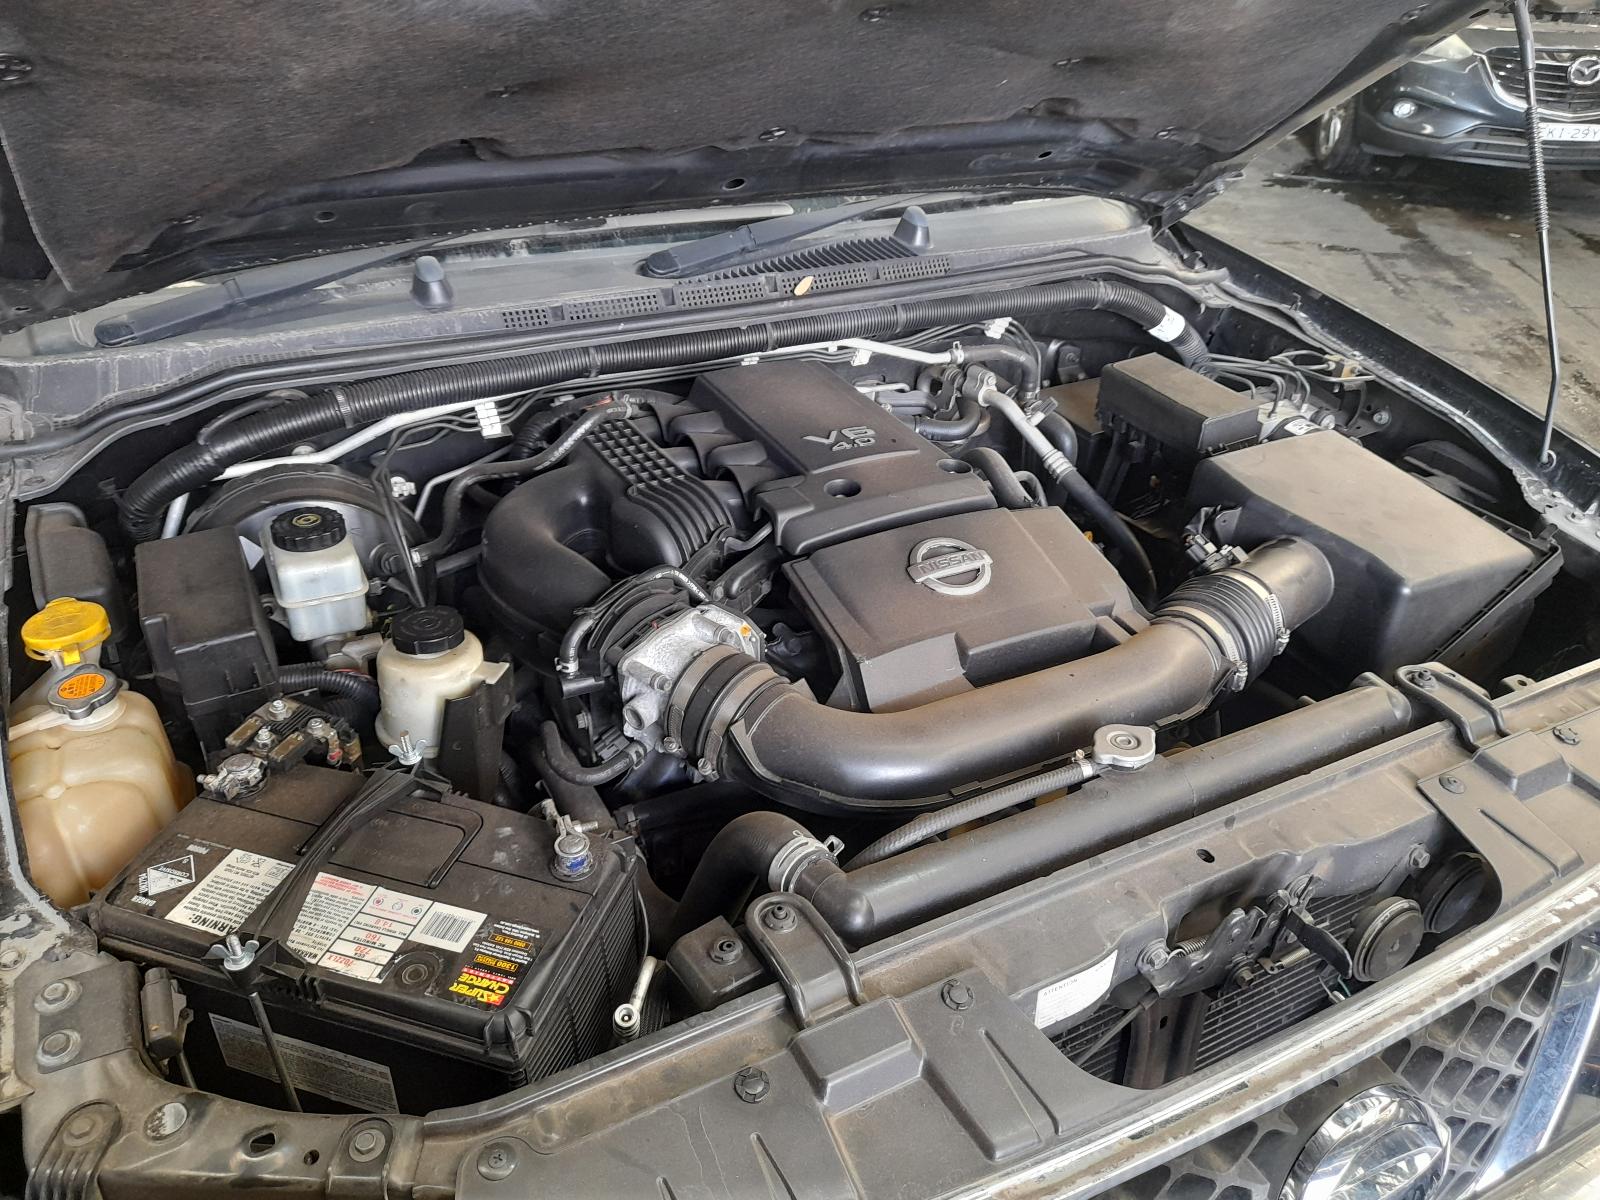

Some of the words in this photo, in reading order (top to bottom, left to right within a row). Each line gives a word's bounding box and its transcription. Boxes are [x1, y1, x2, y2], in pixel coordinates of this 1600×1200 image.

[803, 426, 876, 445] V6
[832, 437, 876, 452] 4.0
[919, 551, 984, 575] NISSAN
[189, 913, 238, 934] ARNING:
[448, 982, 488, 1003] SUPER
[458, 972, 510, 995] CHARGE
